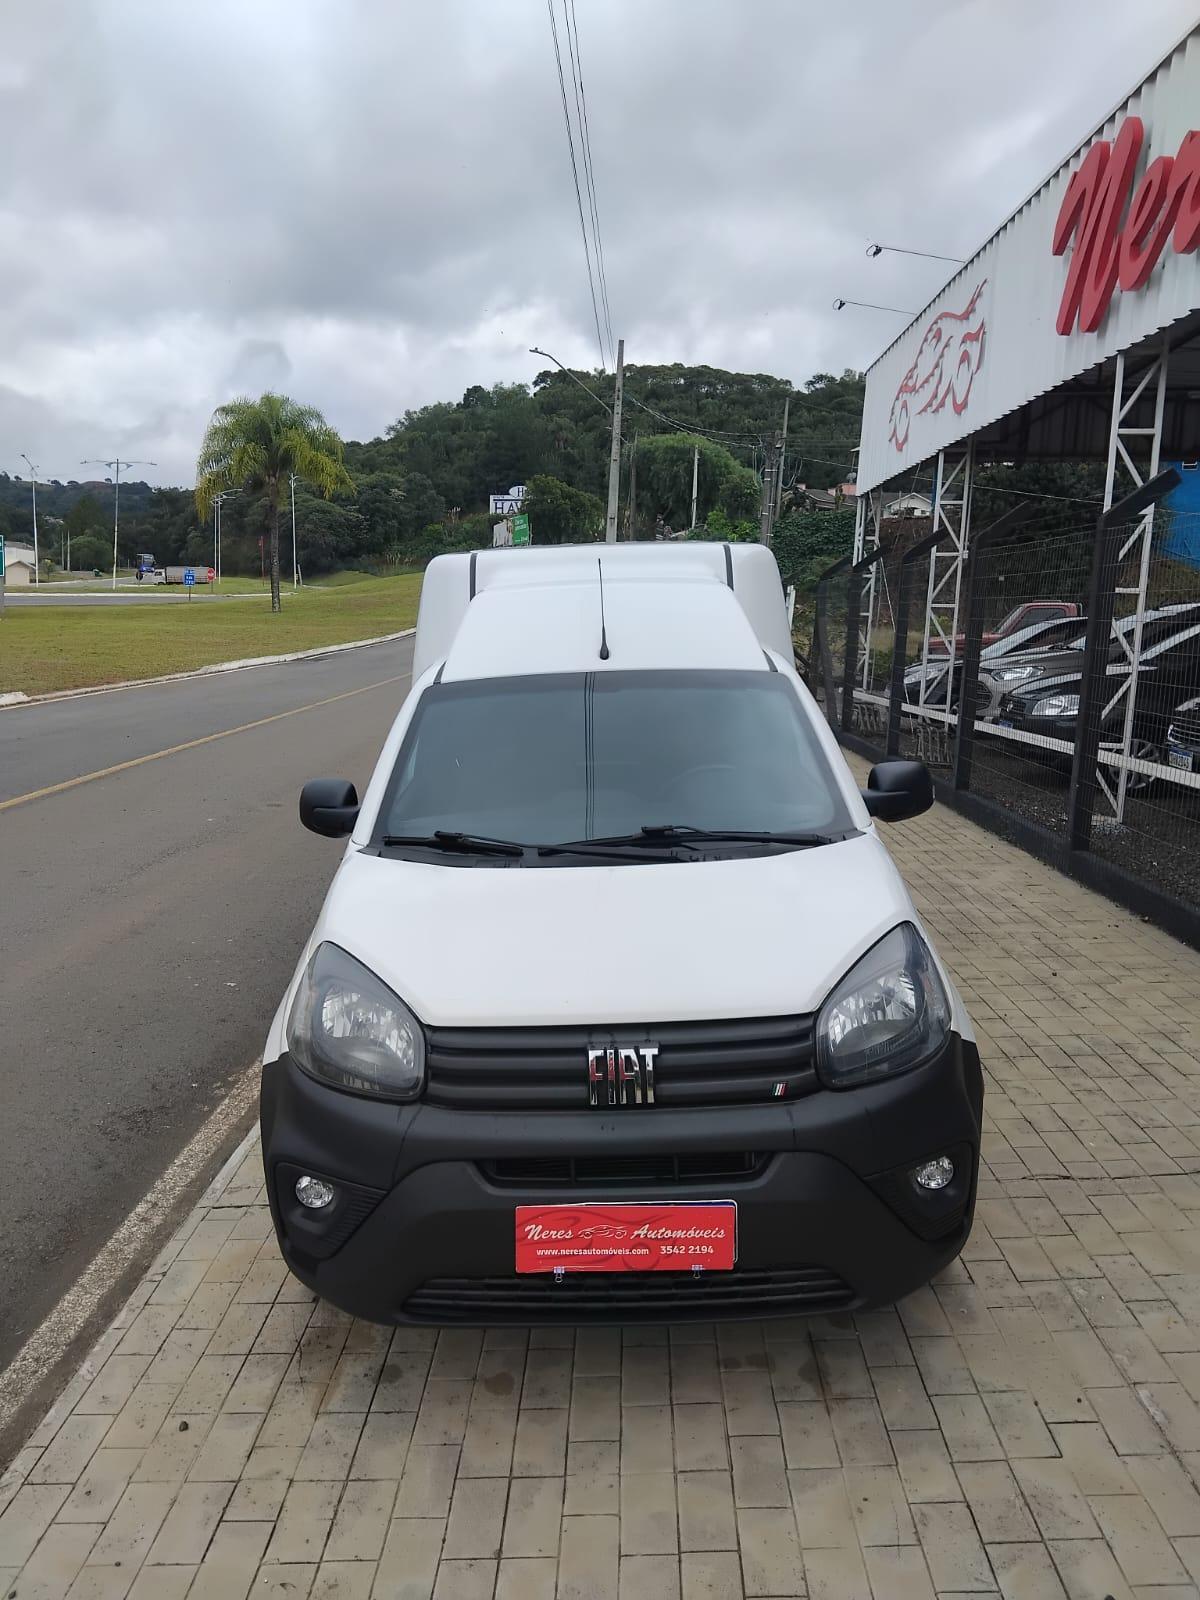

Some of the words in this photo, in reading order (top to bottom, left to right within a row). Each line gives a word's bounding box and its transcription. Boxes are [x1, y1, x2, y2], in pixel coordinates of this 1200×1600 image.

[587, 1046, 660, 1106] FIAT
[524, 1224, 574, 1241] Neres
[629, 1223, 726, 1240] Automóveis
[536, 1246, 650, 1257] www.neresautomóveis.com
[660, 1245, 686, 1255] 3542
[688, 1245, 715, 1255] 2194
